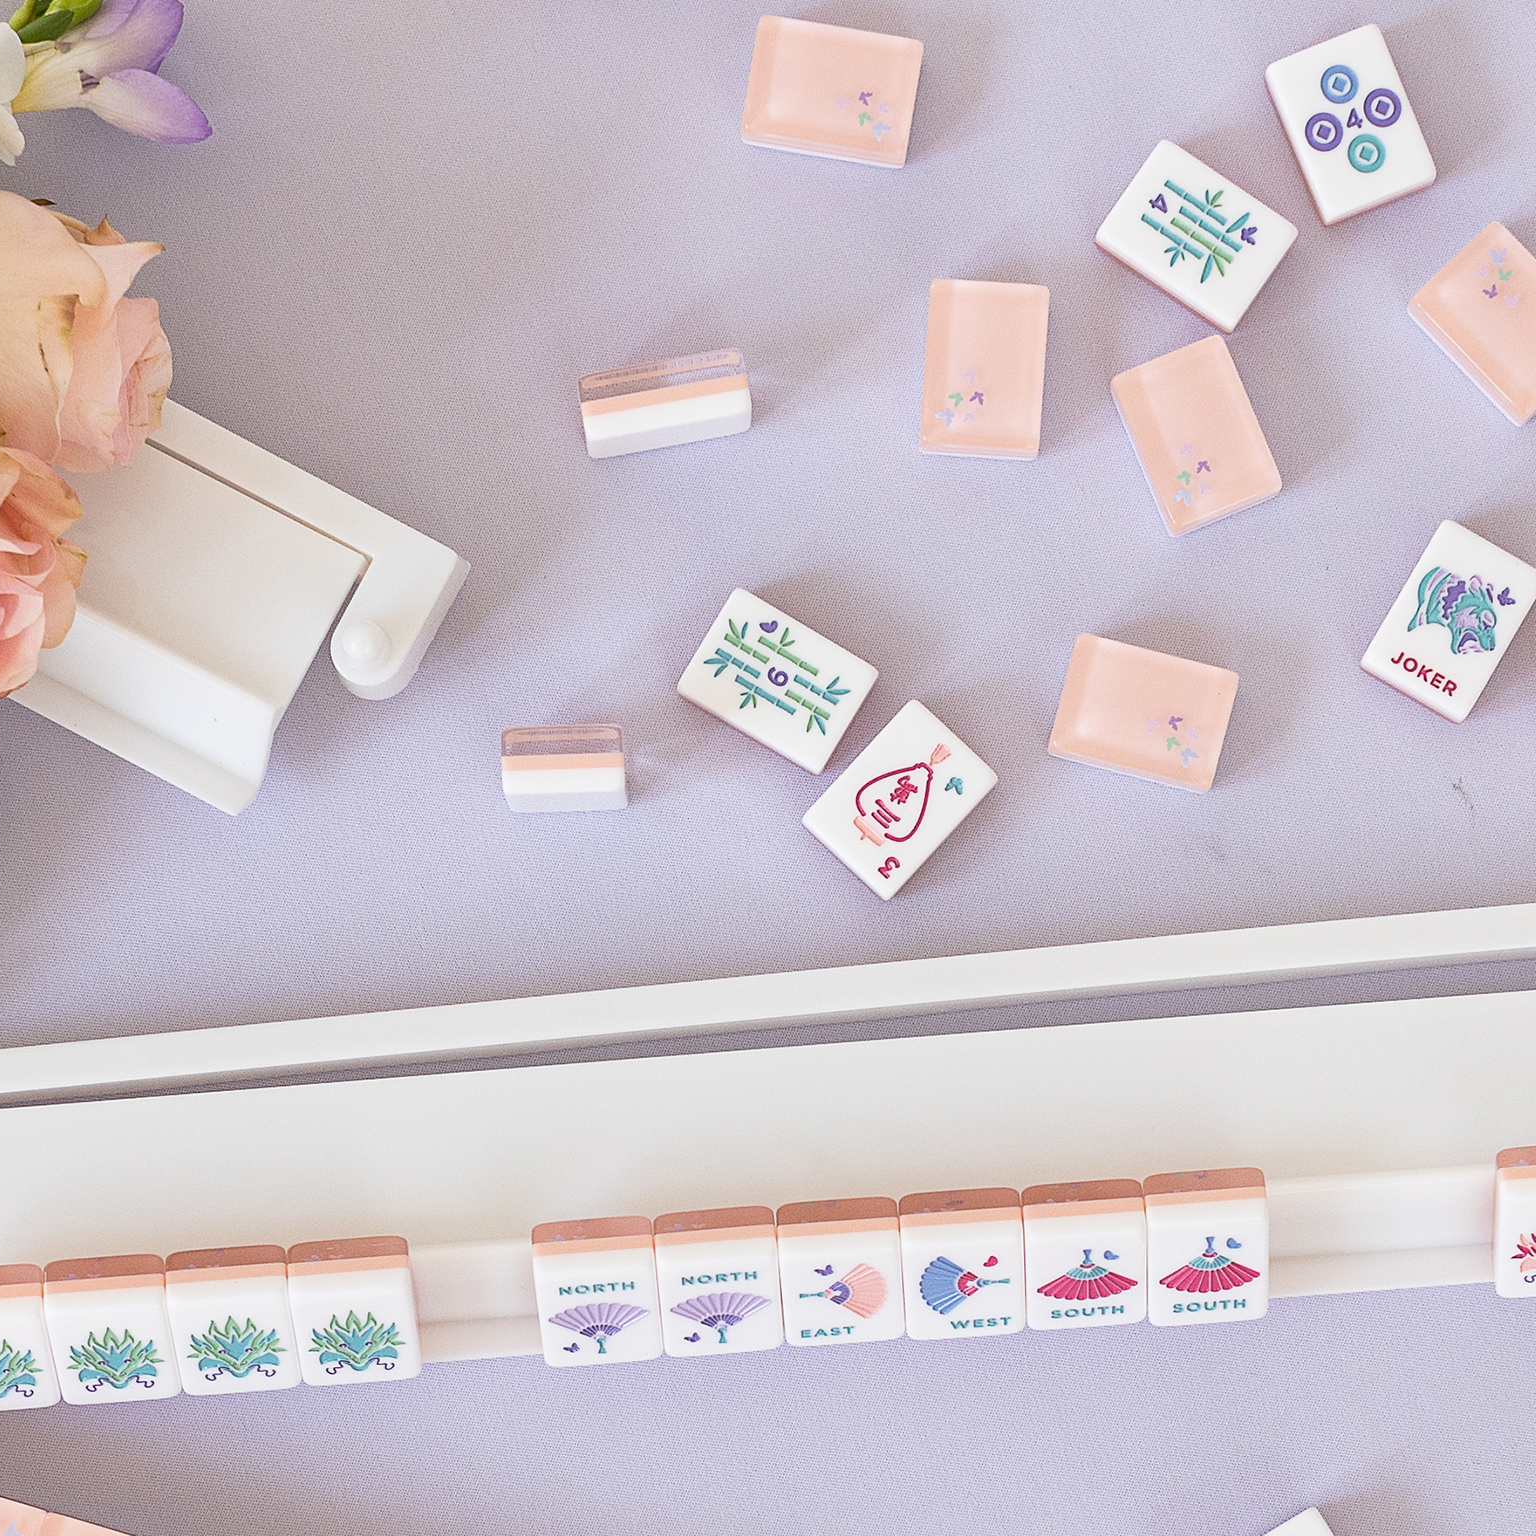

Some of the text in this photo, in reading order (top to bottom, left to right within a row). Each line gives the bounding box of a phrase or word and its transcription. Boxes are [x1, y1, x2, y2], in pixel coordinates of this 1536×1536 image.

[1346, 105, 1365, 129] 4
[1148, 192, 1168, 214] 4
[767, 666, 789, 687] 6
[1390, 651, 1459, 698] JOKER
[877, 856, 901, 880] 3
[681, 1270, 758, 1286] NORTH
[558, 1281, 635, 1296] NORTH
[1050, 1305, 1125, 1320] SOUTH
[1172, 1298, 1246, 1314] SOUTH
[949, 1316, 1012, 1330] WEST
[800, 1325, 855, 1339] EAST
